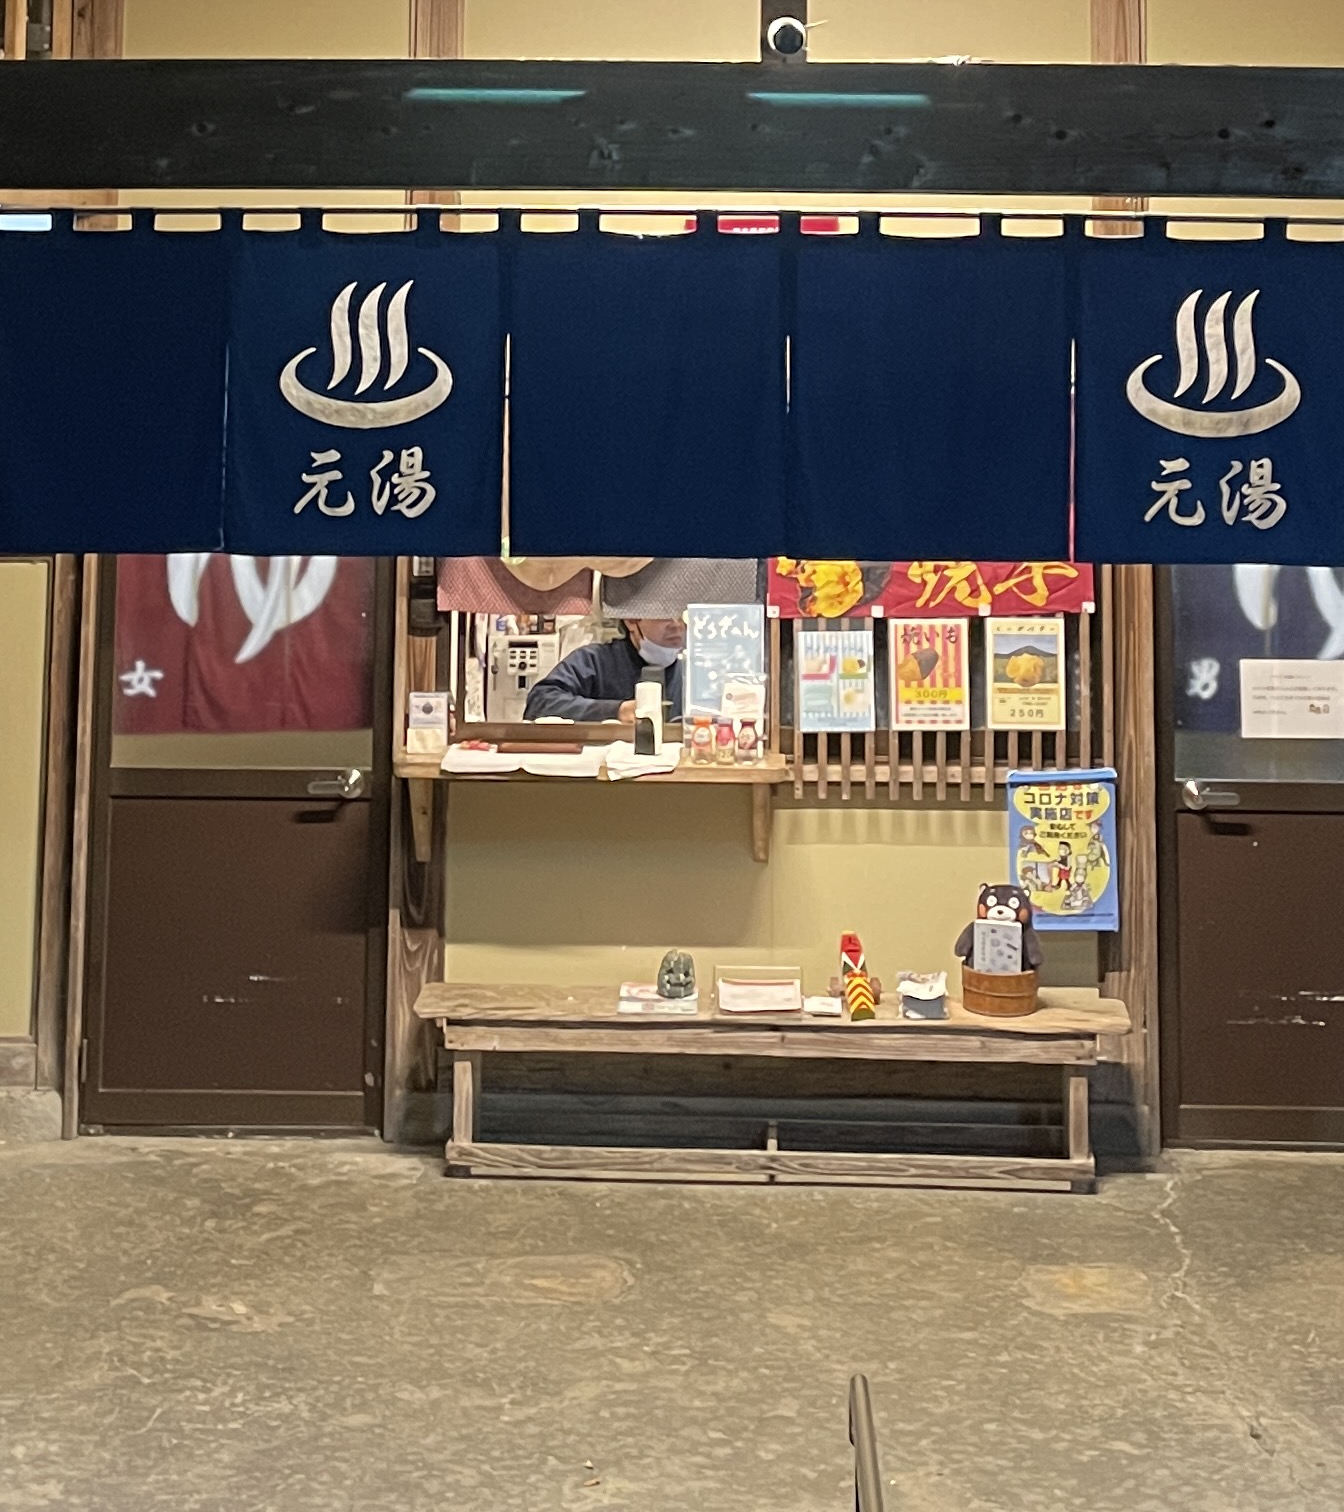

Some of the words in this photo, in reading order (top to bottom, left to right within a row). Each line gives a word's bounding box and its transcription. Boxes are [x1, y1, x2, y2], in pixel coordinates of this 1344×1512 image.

[293, 445, 437, 519] 元湯
[1143, 456, 1288, 530] 元湯
[119, 659, 165, 698] 女
[1023, 791, 1100, 807] コロナ対策
